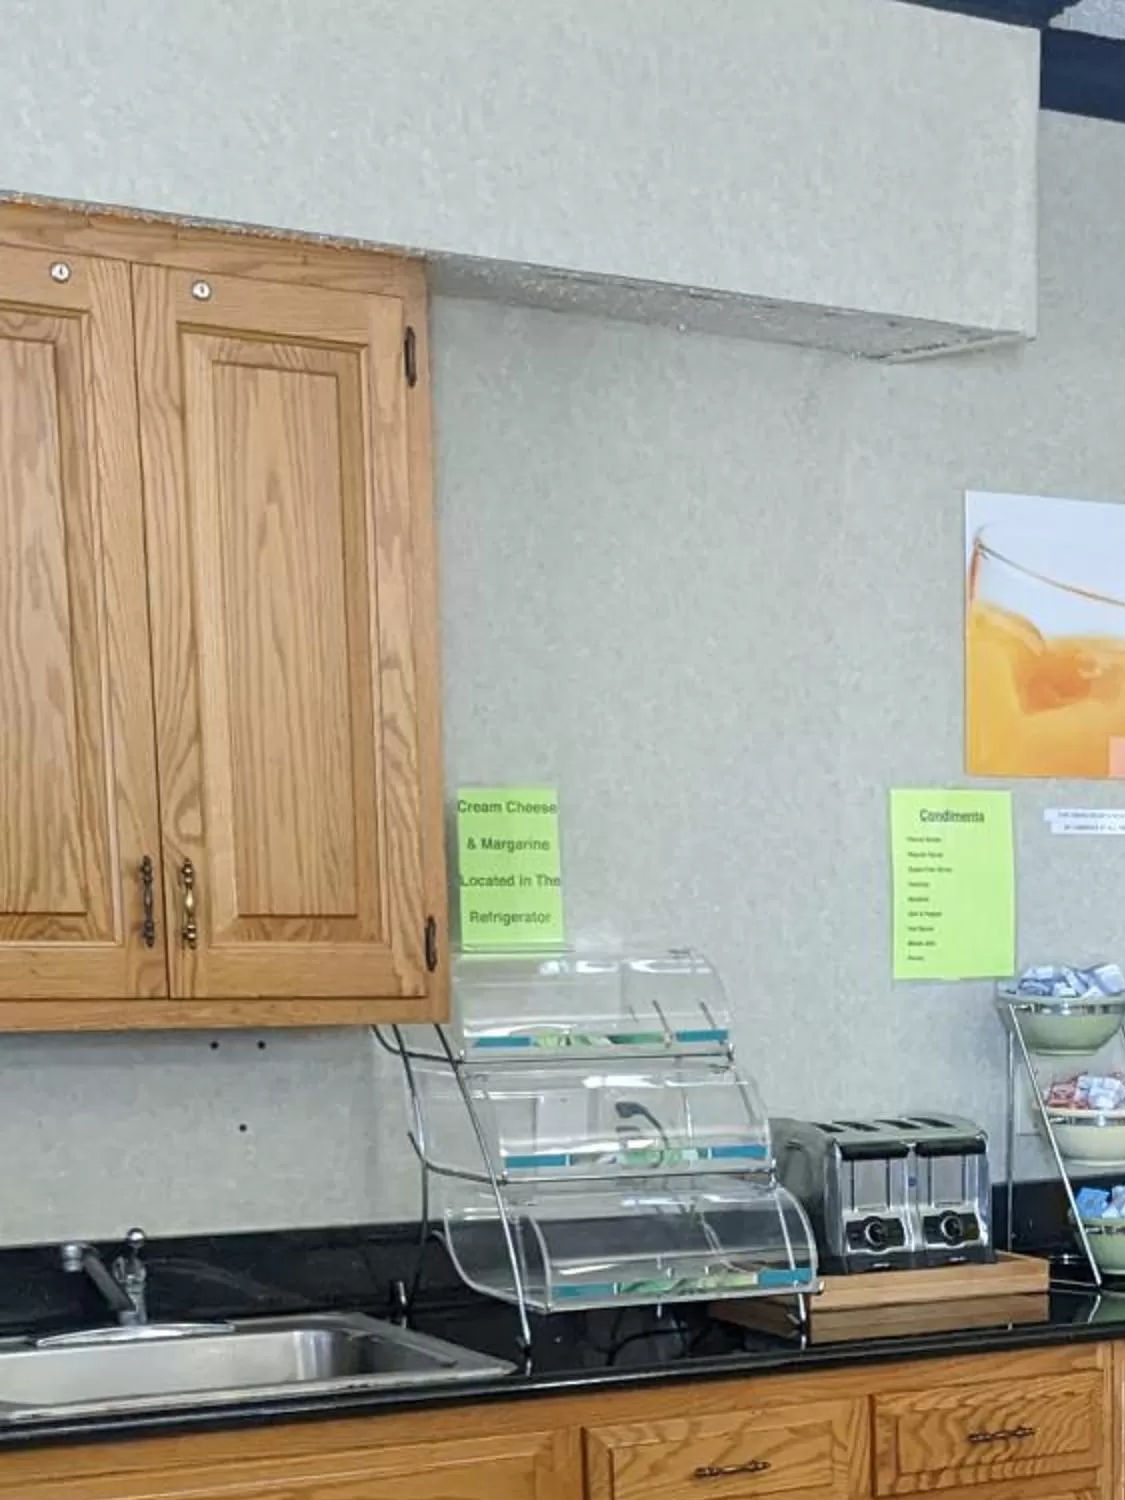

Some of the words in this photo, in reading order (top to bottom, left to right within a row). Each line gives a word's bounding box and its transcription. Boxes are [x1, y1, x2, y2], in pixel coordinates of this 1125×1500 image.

[457, 800, 503, 814] Cream
[506, 800, 558, 814] Cheese
[919, 809, 985, 823] Condiments
[467, 837, 477, 850] &
[481, 837, 551, 853] Margarine
[460, 874, 515, 887] Located
[535, 874, 561, 887] The
[469, 911, 551, 927] Refrigerator
